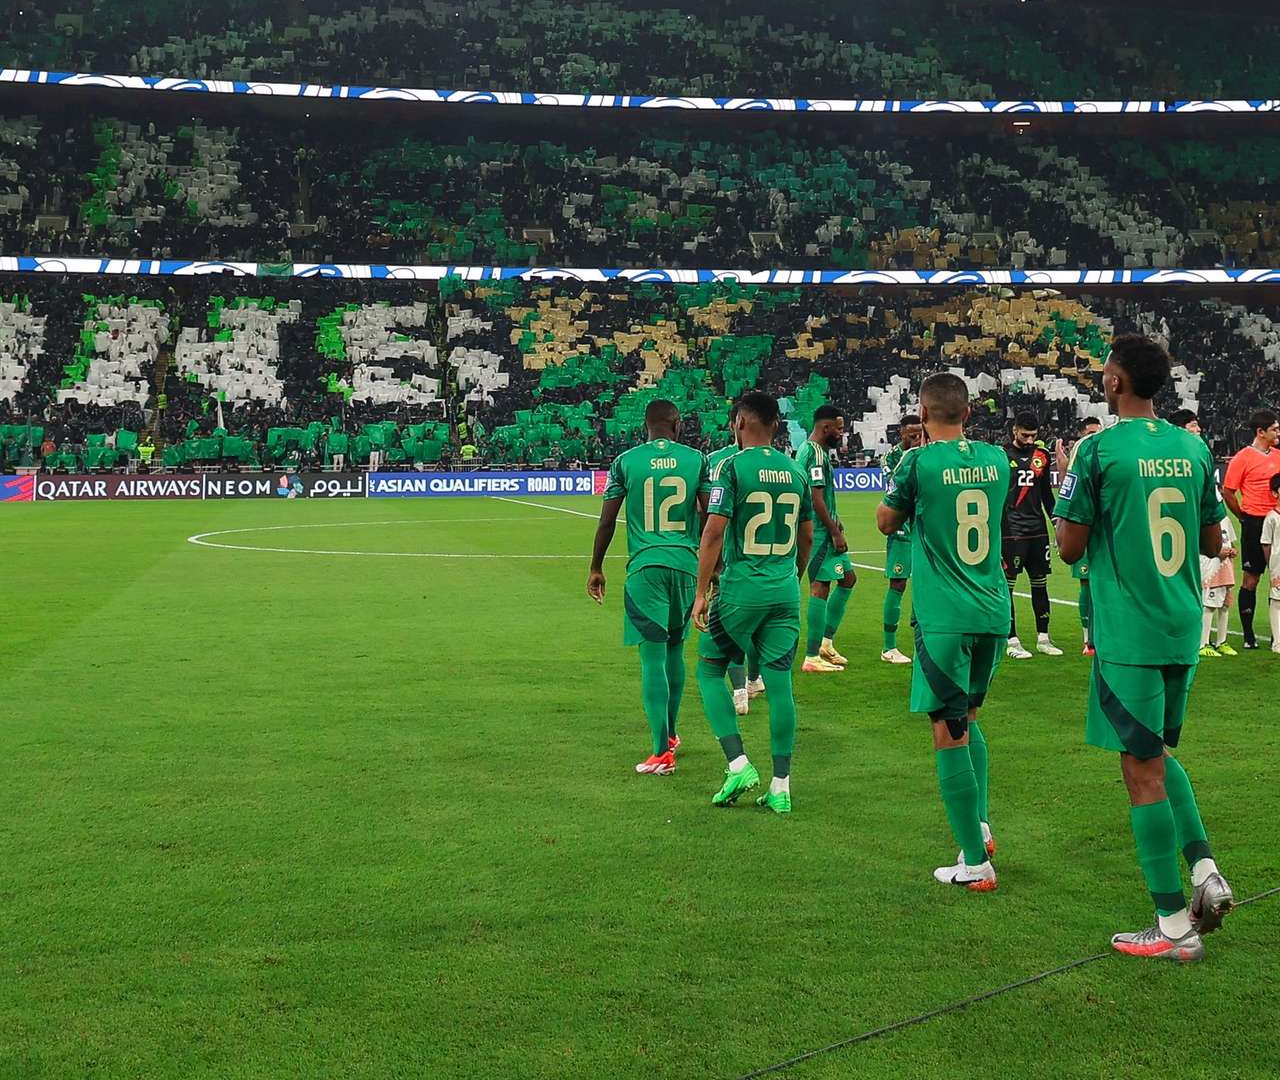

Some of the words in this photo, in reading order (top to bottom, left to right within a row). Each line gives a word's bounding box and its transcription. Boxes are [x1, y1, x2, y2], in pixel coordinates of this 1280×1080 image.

[650, 457, 677, 469] SAUD
[1138, 459, 1192, 477] NASSER
[527, 477, 556, 491] ROAD
[559, 477, 573, 491] TO
[576, 476, 591, 491] 26
[759, 469, 792, 484] AIMAN
[942, 466, 1000, 486] ALMALKI
[1018, 470, 1035, 486] 22
[37, 480, 107, 500] QATAR
[115, 479, 201, 496] AIRWAYS
[207, 480, 271, 495] NEOM
[310, 476, 362, 497] نيوم
[376, 479, 426, 493] ASIAN
[644, 477, 687, 531] 12
[743, 491, 801, 556] 23
[955, 488, 989, 566] 8
[1148, 487, 1186, 577] 6
